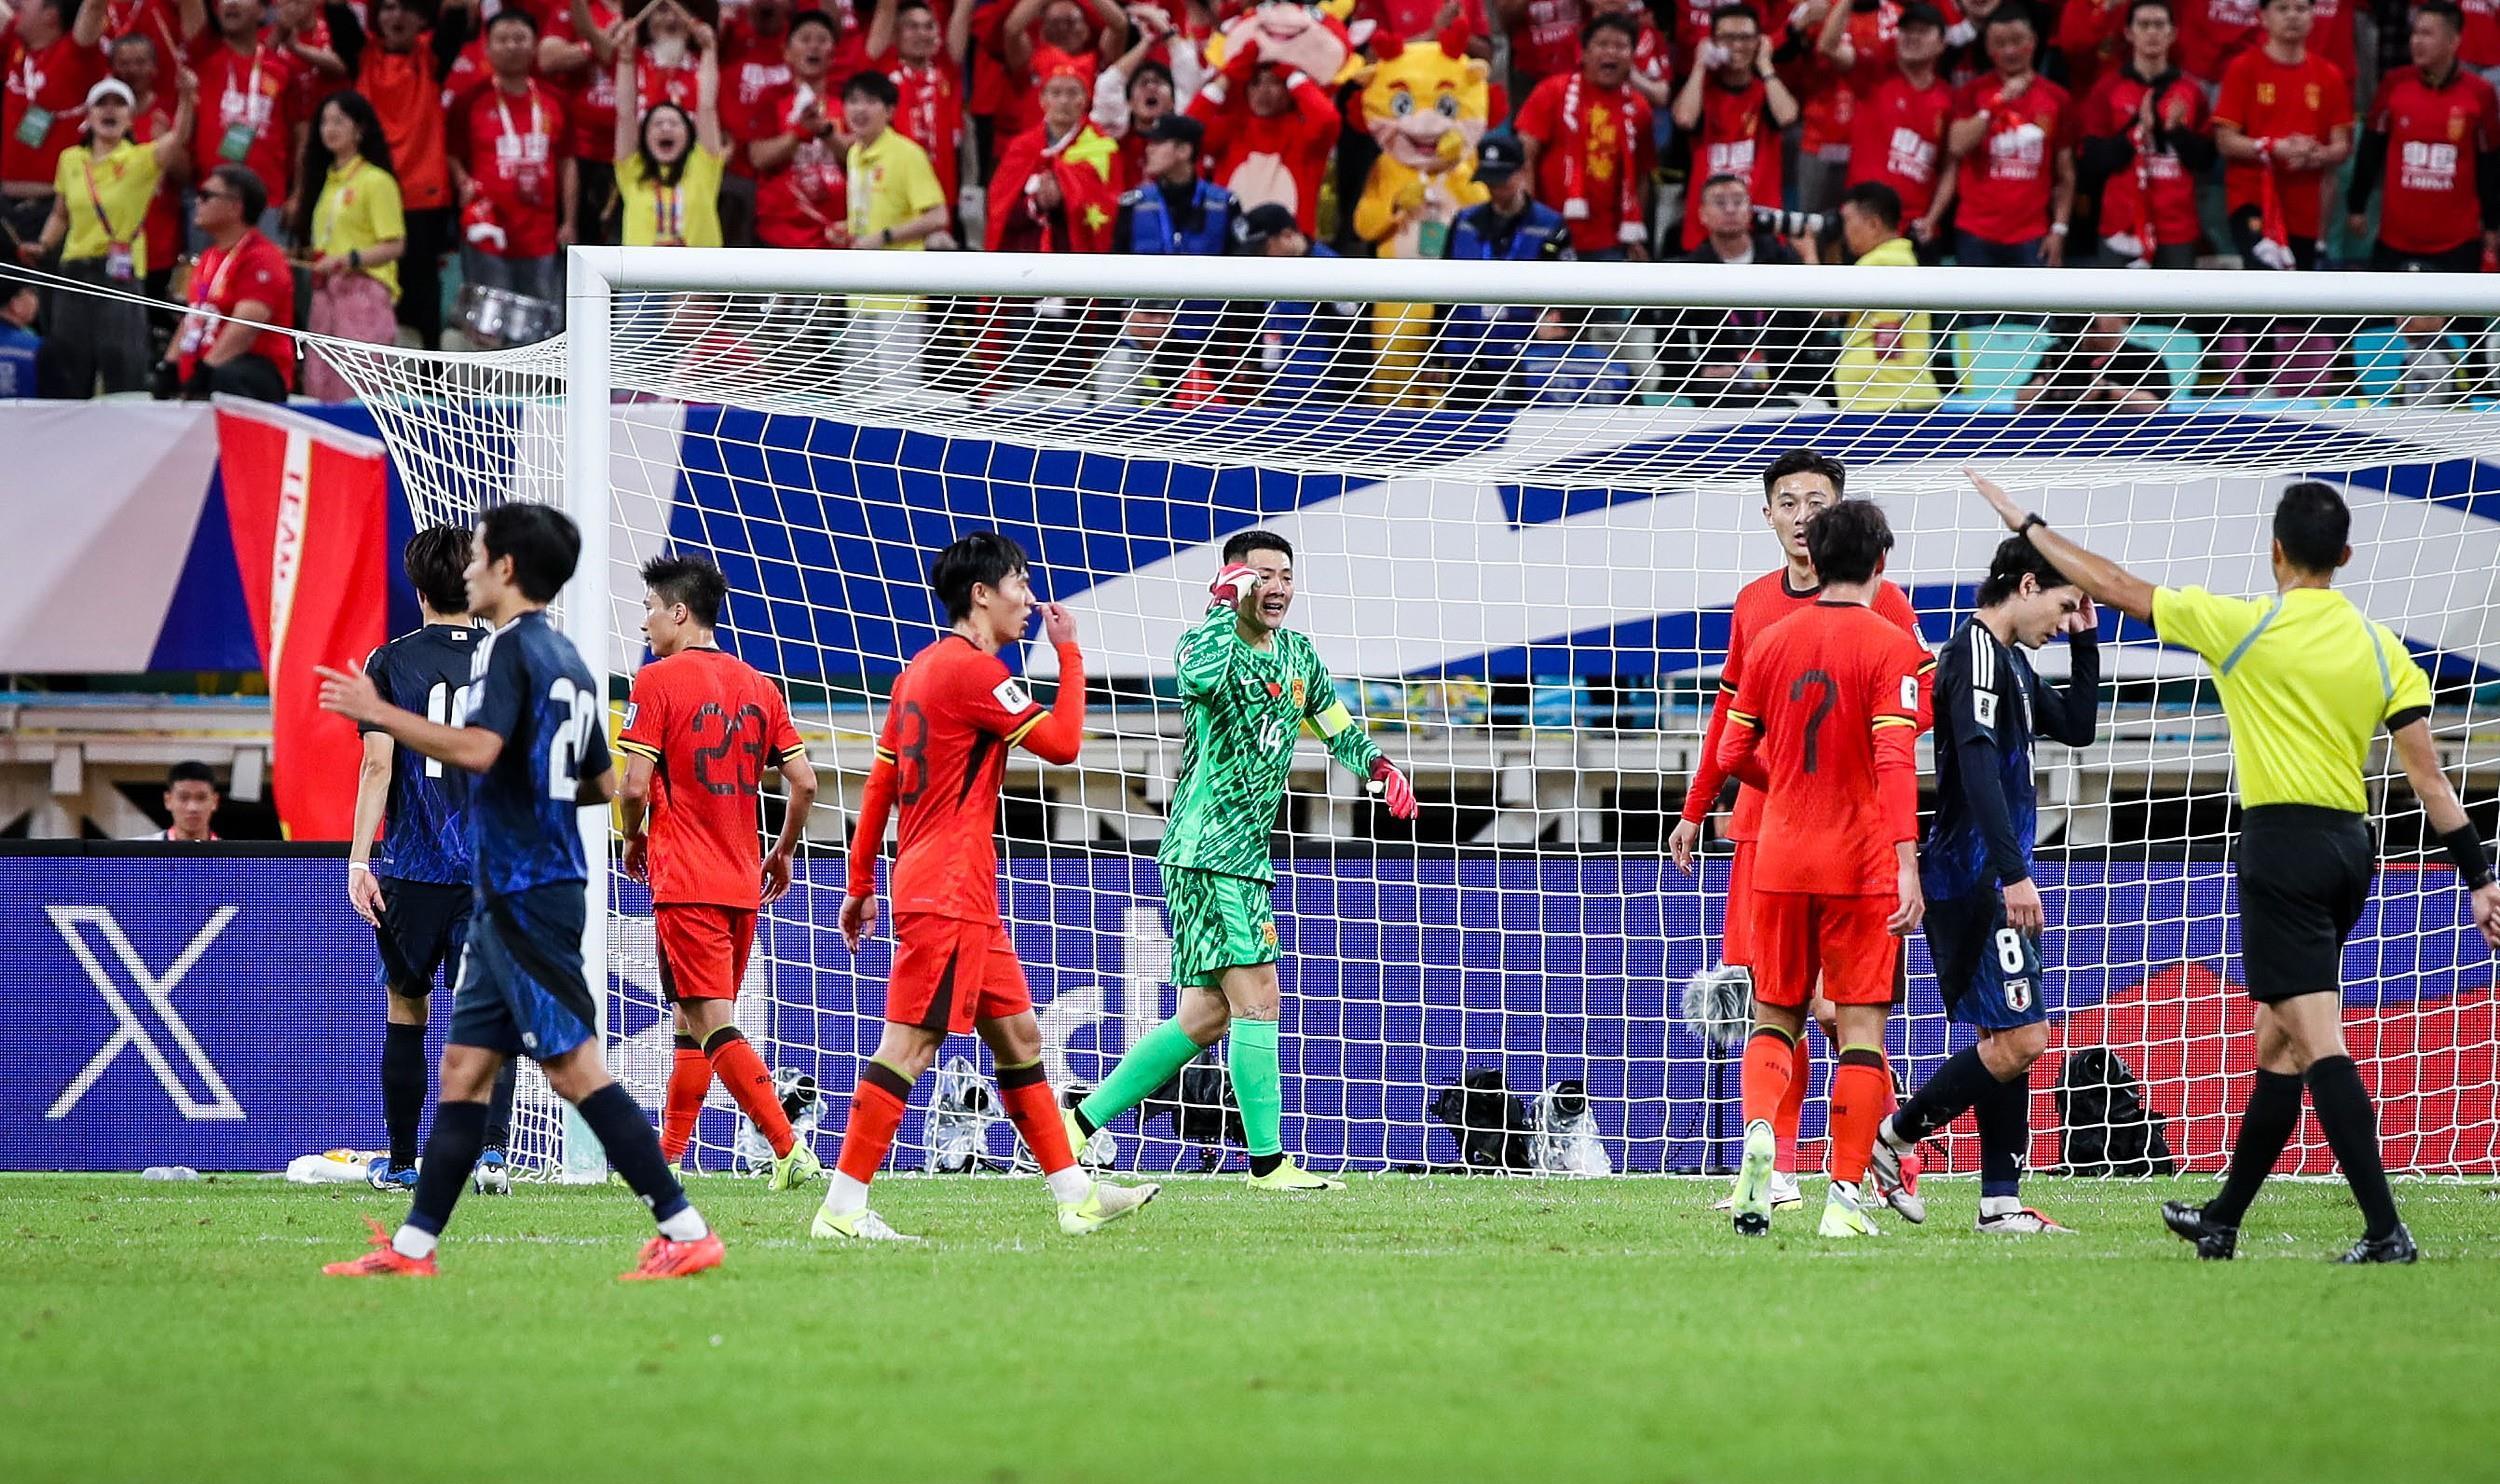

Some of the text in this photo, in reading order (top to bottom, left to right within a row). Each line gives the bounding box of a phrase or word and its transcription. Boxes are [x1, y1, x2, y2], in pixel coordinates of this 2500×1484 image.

[549, 677, 595, 801] 20
[692, 702, 768, 796] 23
[1258, 714, 1286, 755] 14
[1789, 669, 1838, 774] 7
[1995, 928, 2024, 974] 8
[46, 905, 247, 1122] X
